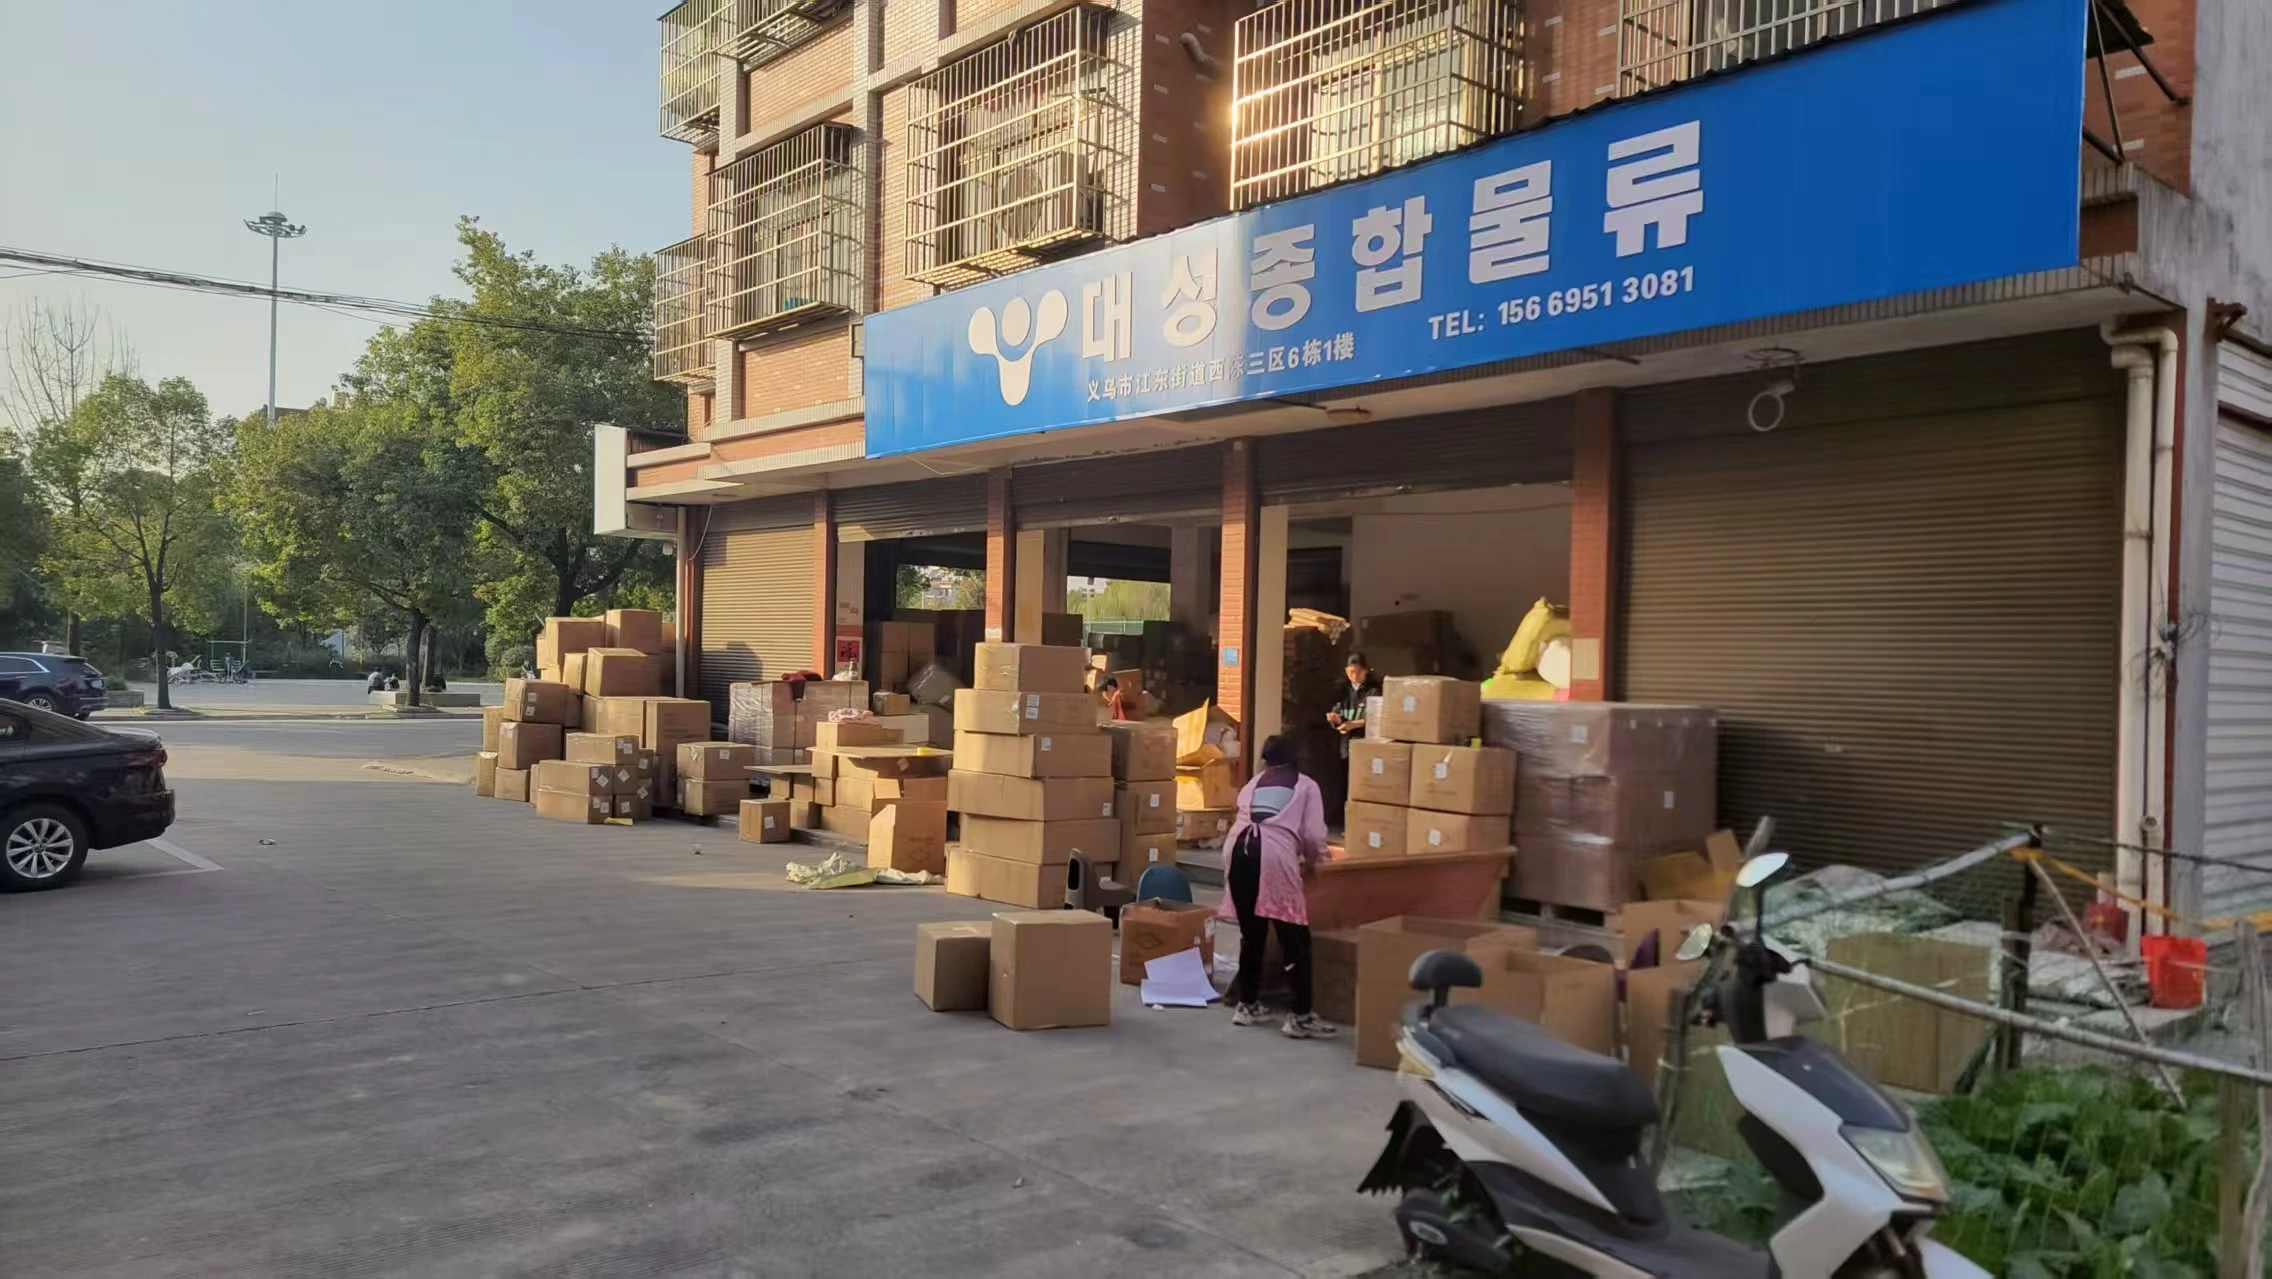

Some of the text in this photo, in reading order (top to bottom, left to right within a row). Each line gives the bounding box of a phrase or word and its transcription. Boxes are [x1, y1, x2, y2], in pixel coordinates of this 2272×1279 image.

[1428, 265, 1694, 340] TEL: 156 6951 3081
